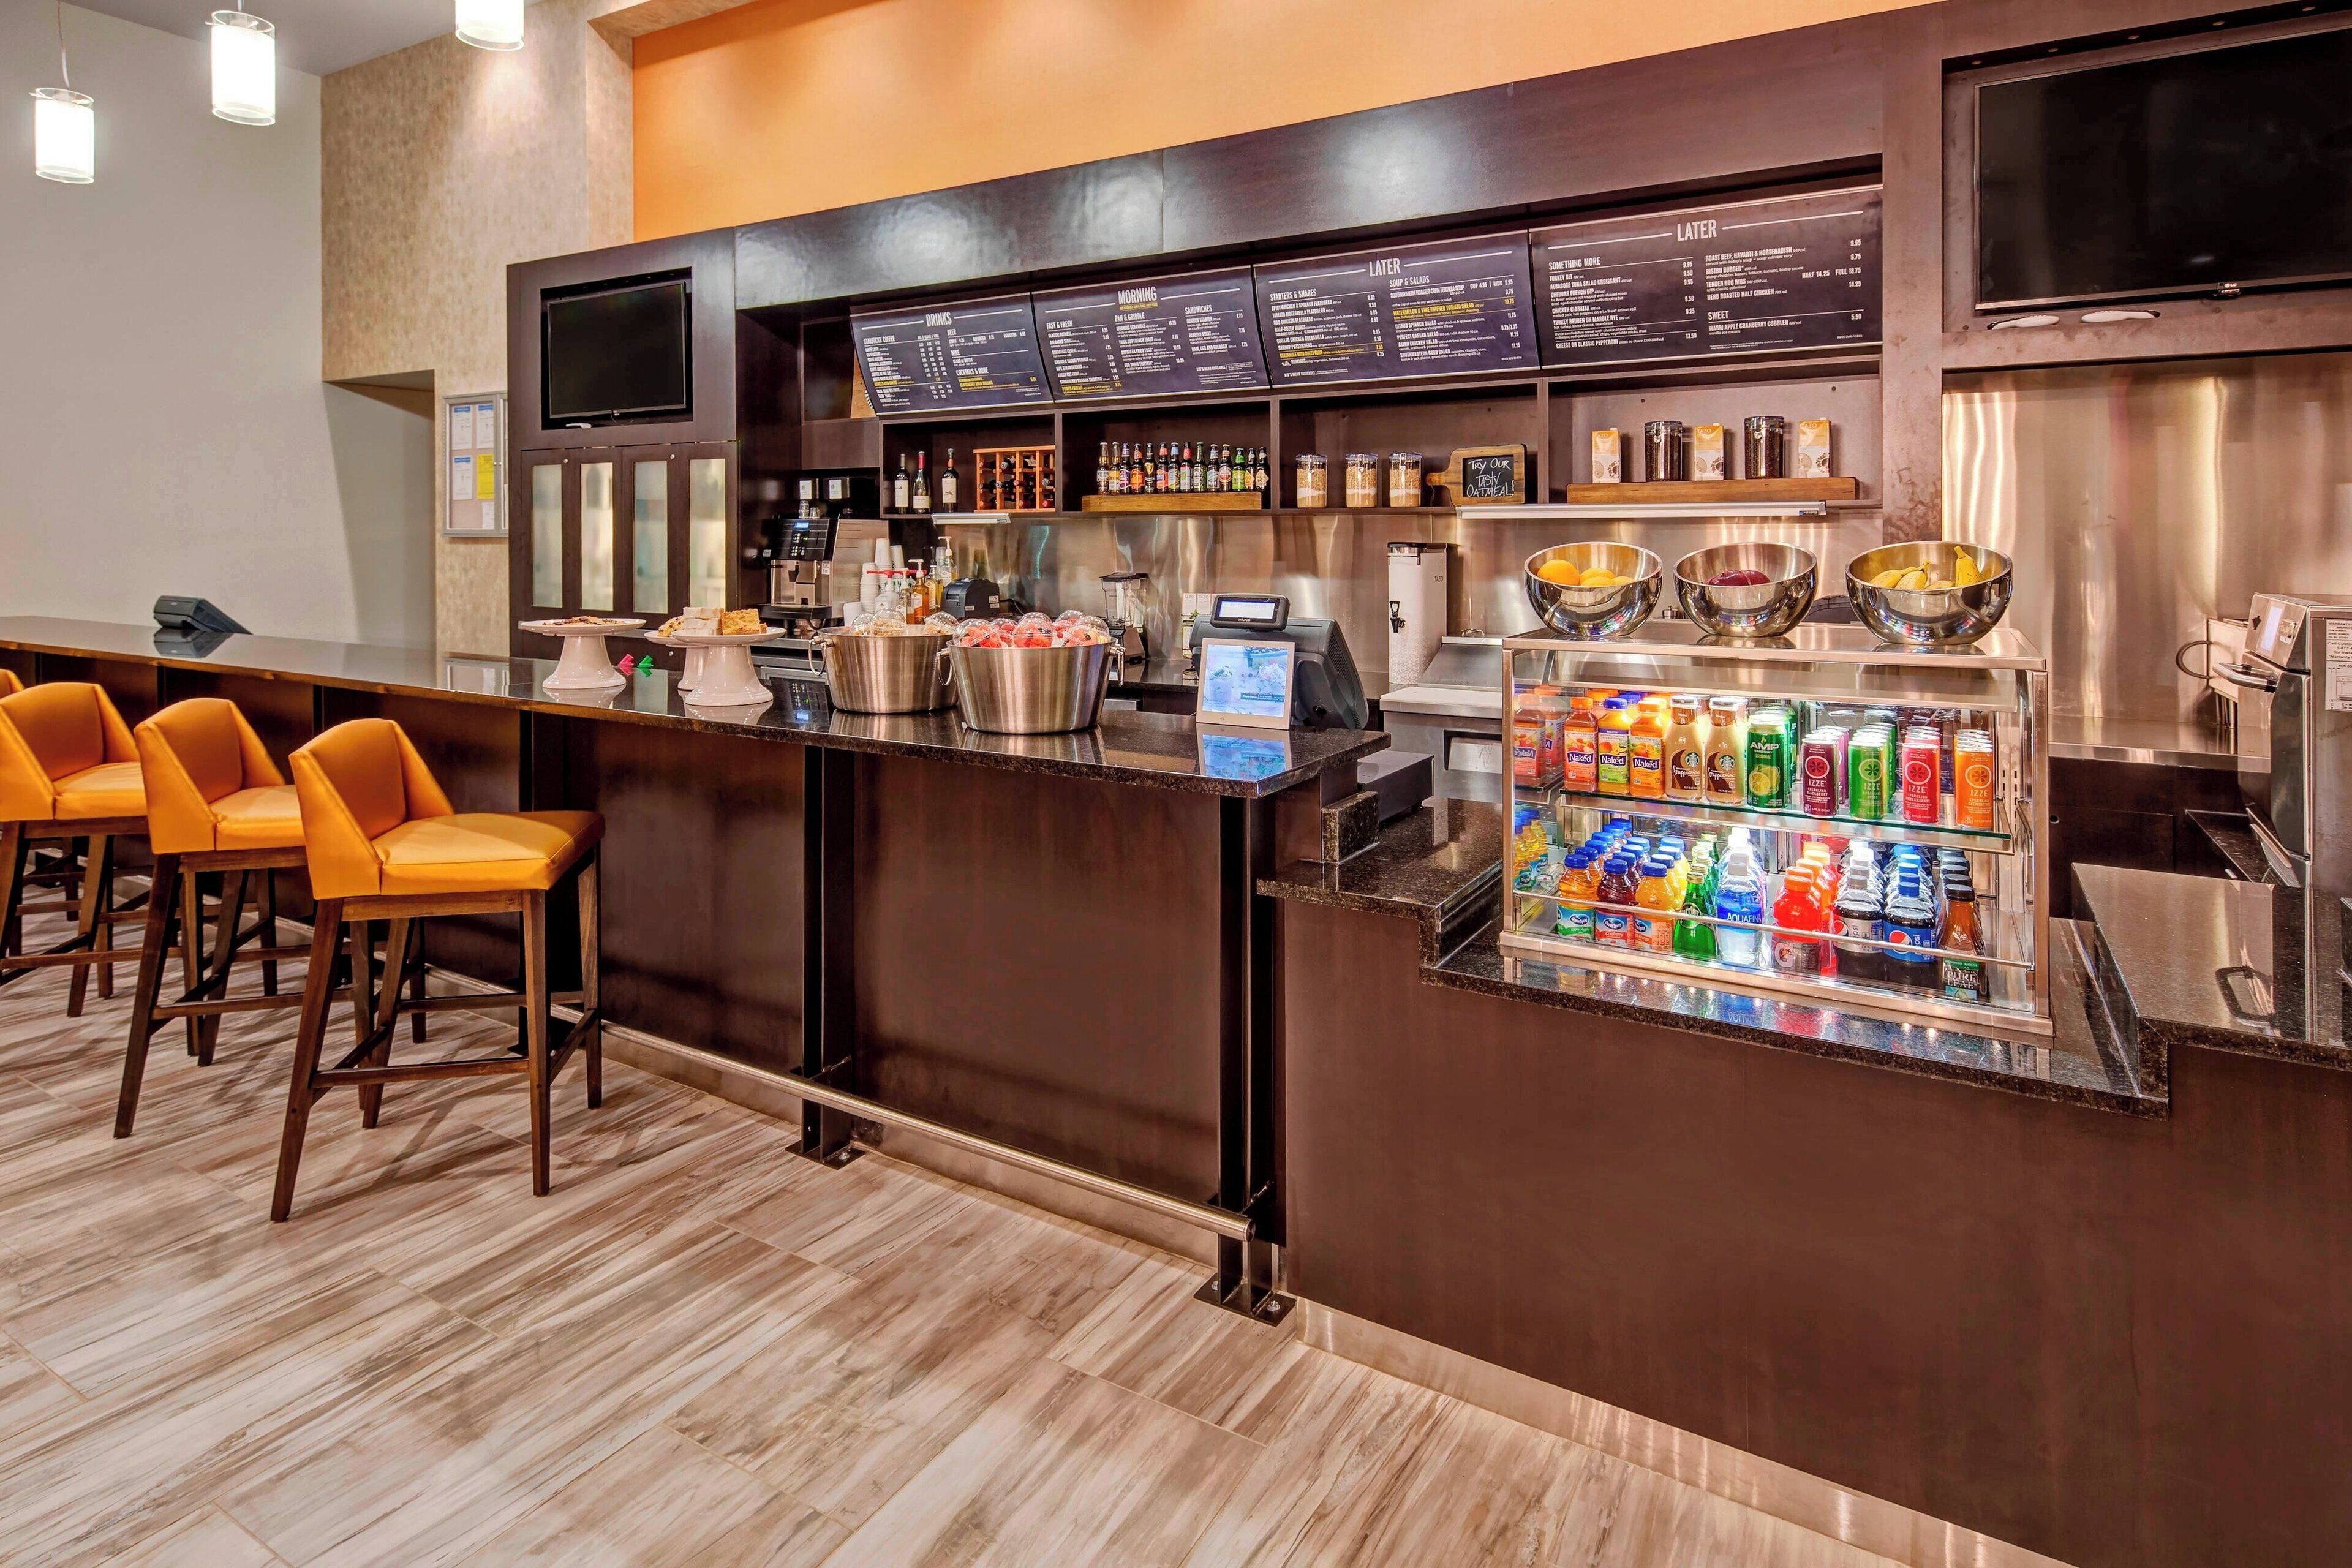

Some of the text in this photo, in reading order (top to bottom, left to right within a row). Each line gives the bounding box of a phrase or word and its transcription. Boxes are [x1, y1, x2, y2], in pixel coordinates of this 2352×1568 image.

[1676, 220, 1717, 241] LATER
[1759, 247, 1792, 256] HORSERADISH
[1369, 258, 1401, 277] LATER
[1549, 257, 1600, 270] SOMETHING MORE
[1389, 279, 1403, 288] SOUP
[1410, 276, 1430, 285] SALADS
[1118, 287, 1157, 304] MORNING
[1270, 292, 1293, 301] STARTERS
[1298, 289, 1317, 298] SHARES
[1185, 305, 1213, 314] SANDWICHES
[925, 312, 952, 327] DRINKS
[1128, 312, 1145, 321] GRIDDLE
[1708, 311, 1729, 320] SWEET
[1490, 458, 1511, 470] OUR
[1750, 741, 1779, 750] AMP
[1909, 785, 1926, 794] IZZE
[1947, 971, 1977, 981] PURE
[1947, 979, 1974, 989] LEAF
